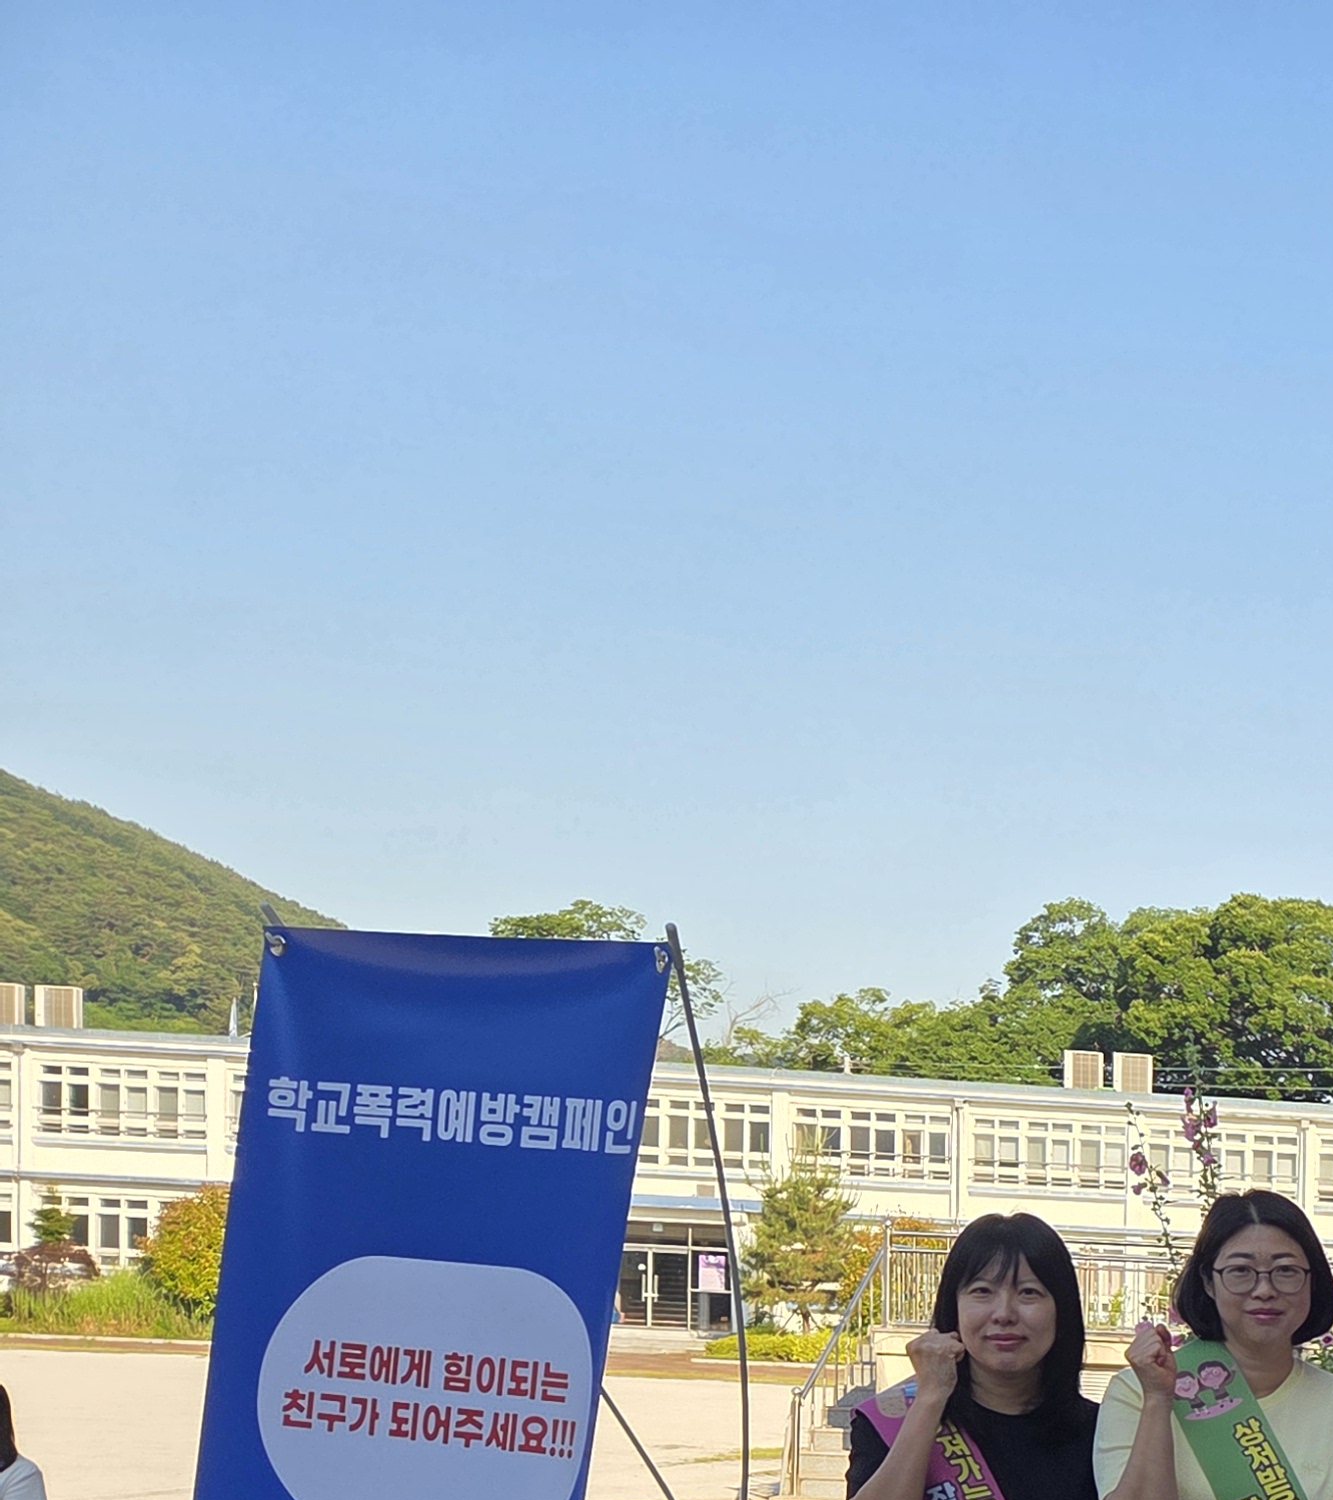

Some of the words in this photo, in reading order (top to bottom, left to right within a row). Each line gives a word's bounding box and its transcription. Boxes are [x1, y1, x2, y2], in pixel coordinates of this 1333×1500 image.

[267, 1076, 638, 1155] 학교폭력예방캠페인
[303, 1339, 432, 1389] 서로에게
[443, 1352, 569, 1404] 힘이되는
[281, 1388, 380, 1438] 친구가
[388, 1400, 577, 1460] 되어주세요!!!
